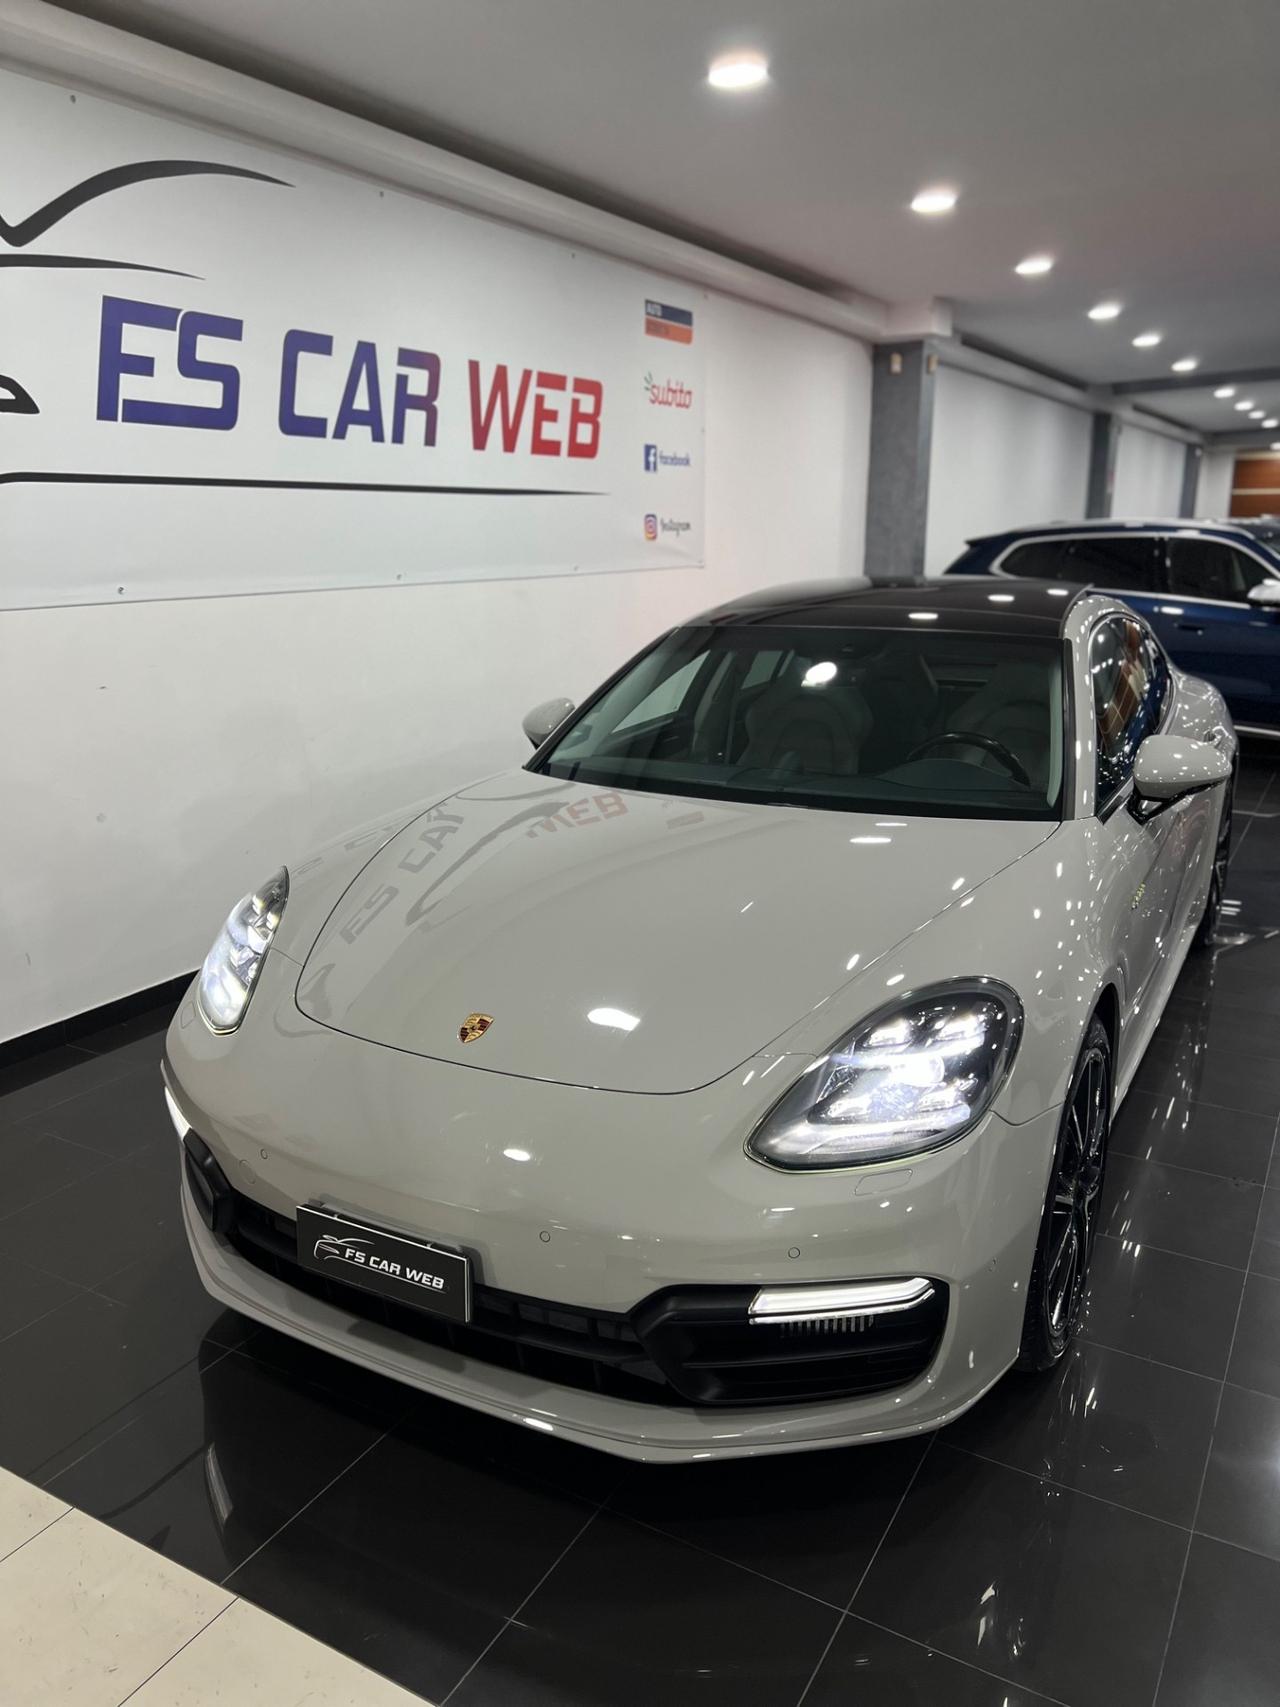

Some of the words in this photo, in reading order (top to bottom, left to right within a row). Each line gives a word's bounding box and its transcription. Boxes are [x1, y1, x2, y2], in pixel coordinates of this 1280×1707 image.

[96, 294, 243, 431] FS
[278, 328, 441, 447] CAR
[468, 359, 604, 459] WEB
[649, 377, 693, 409] subito
[659, 451, 691, 467] facebook
[660, 518, 691, 537] Instagram
[344, 1248, 366, 1264] FS
[369, 1256, 401, 1275] CAR
[405, 1267, 445, 1290] WEB
